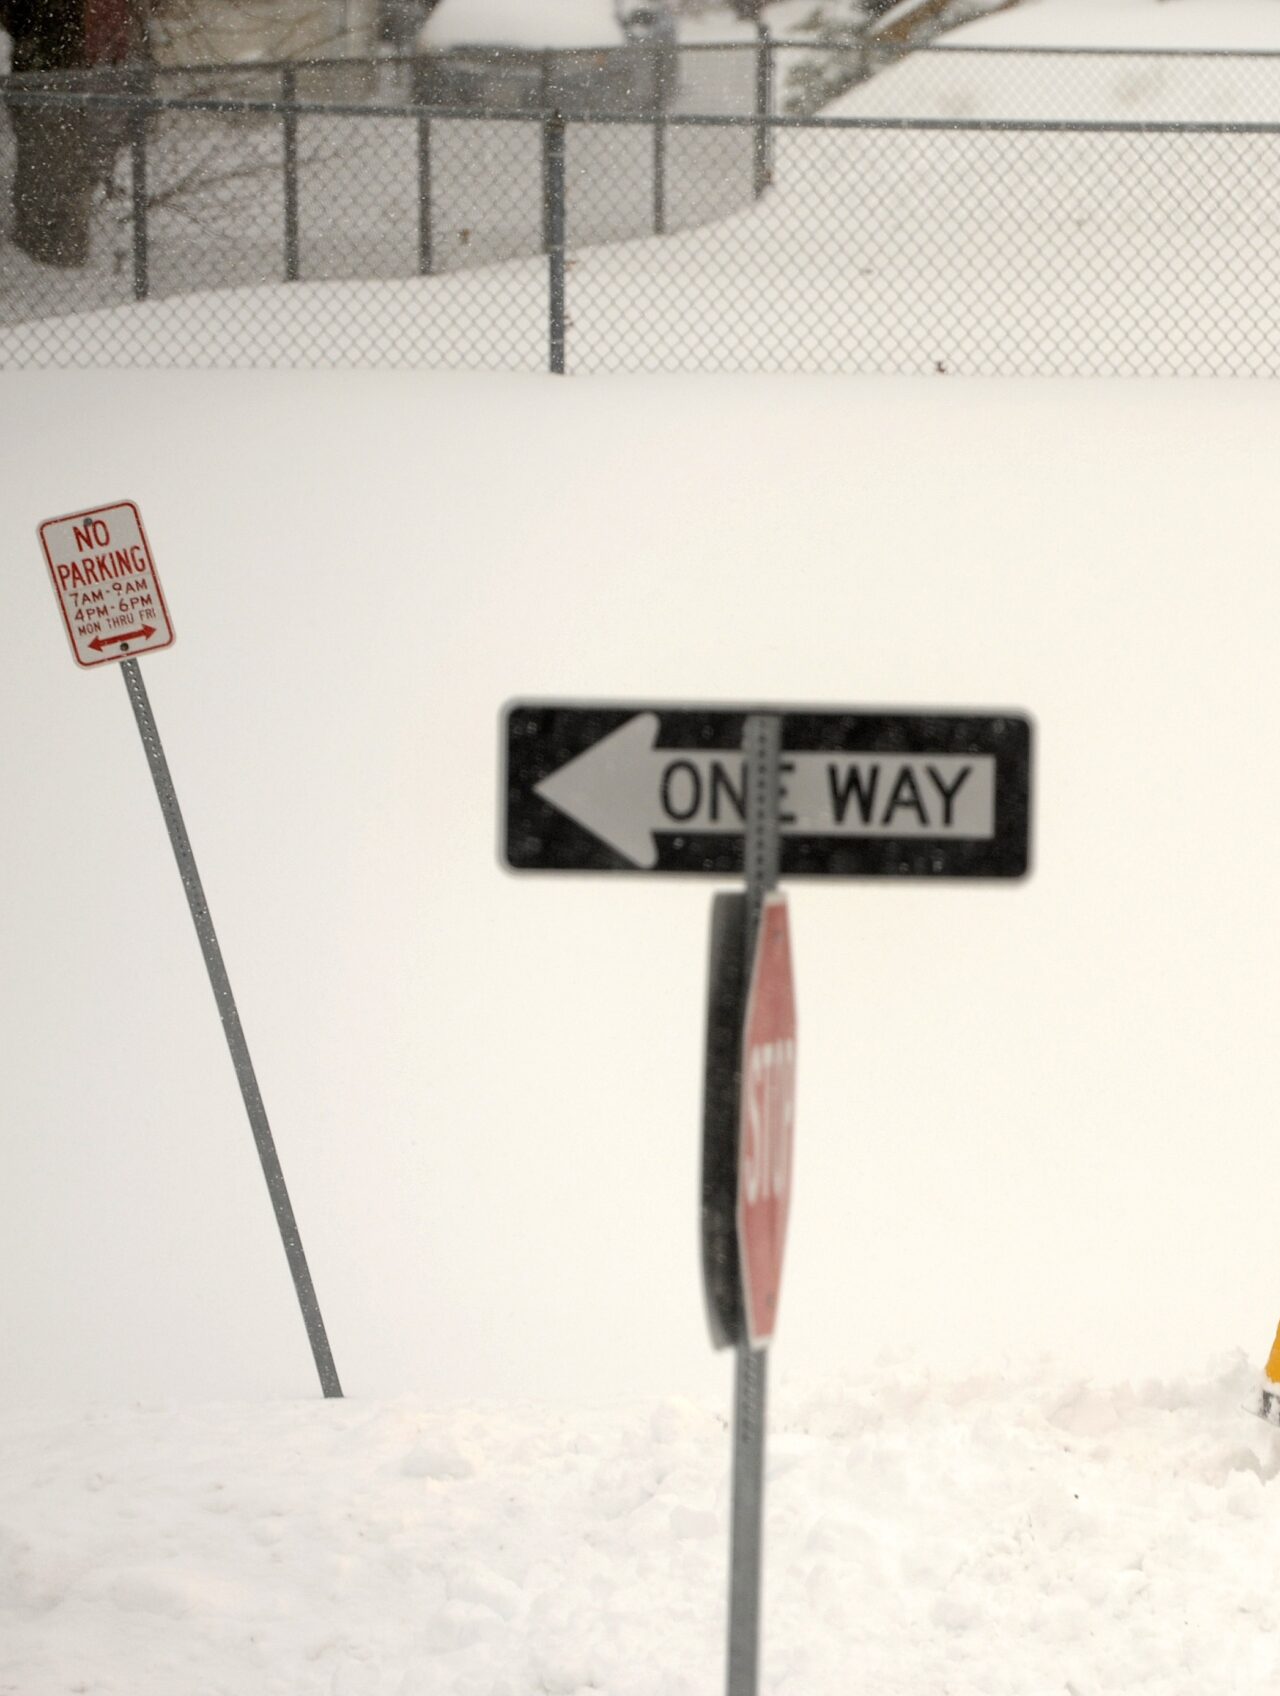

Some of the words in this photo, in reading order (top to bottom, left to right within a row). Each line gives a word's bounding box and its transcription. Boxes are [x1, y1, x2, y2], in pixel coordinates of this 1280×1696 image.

[73, 520, 110, 552] NO
[57, 546, 146, 591] PARKING
[78, 622, 102, 636] MON
[106, 614, 134, 629] THRU
[138, 608, 156, 621] FRI
[827, 763, 972, 827] WAY
